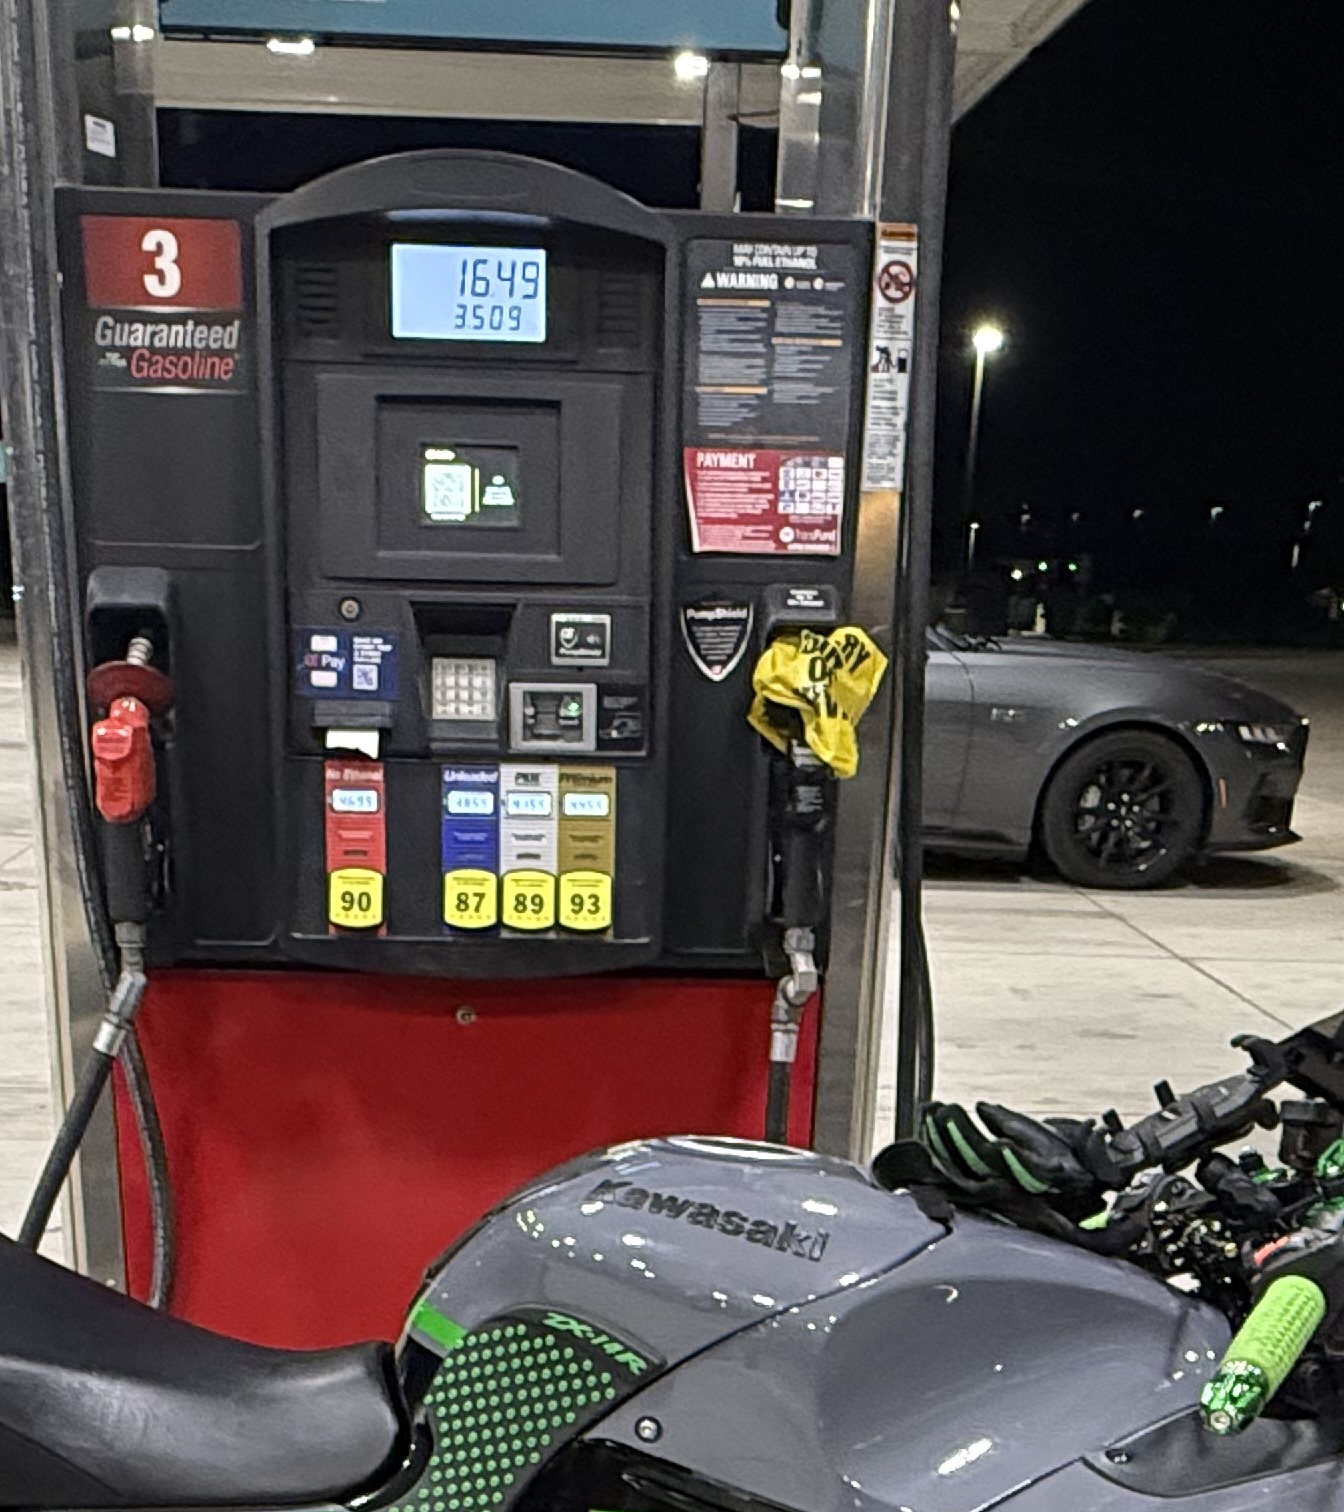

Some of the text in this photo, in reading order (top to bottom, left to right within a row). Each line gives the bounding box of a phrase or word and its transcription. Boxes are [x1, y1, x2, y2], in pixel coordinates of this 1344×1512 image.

[141, 229, 182, 297] 3
[716, 272, 778, 290] WARNING
[95, 315, 240, 350] Guaranteed
[130, 349, 234, 380] Gasoline
[696, 452, 756, 468] PAYMENT
[321, 654, 346, 671] Pay
[340, 891, 372, 912] 90
[455, 892, 486, 913] 87
[513, 893, 545, 915] 89
[570, 893, 601, 915] 93
[590, 1179, 830, 1262] Kawasaki
[542, 1312, 648, 1376] ZX-14R
